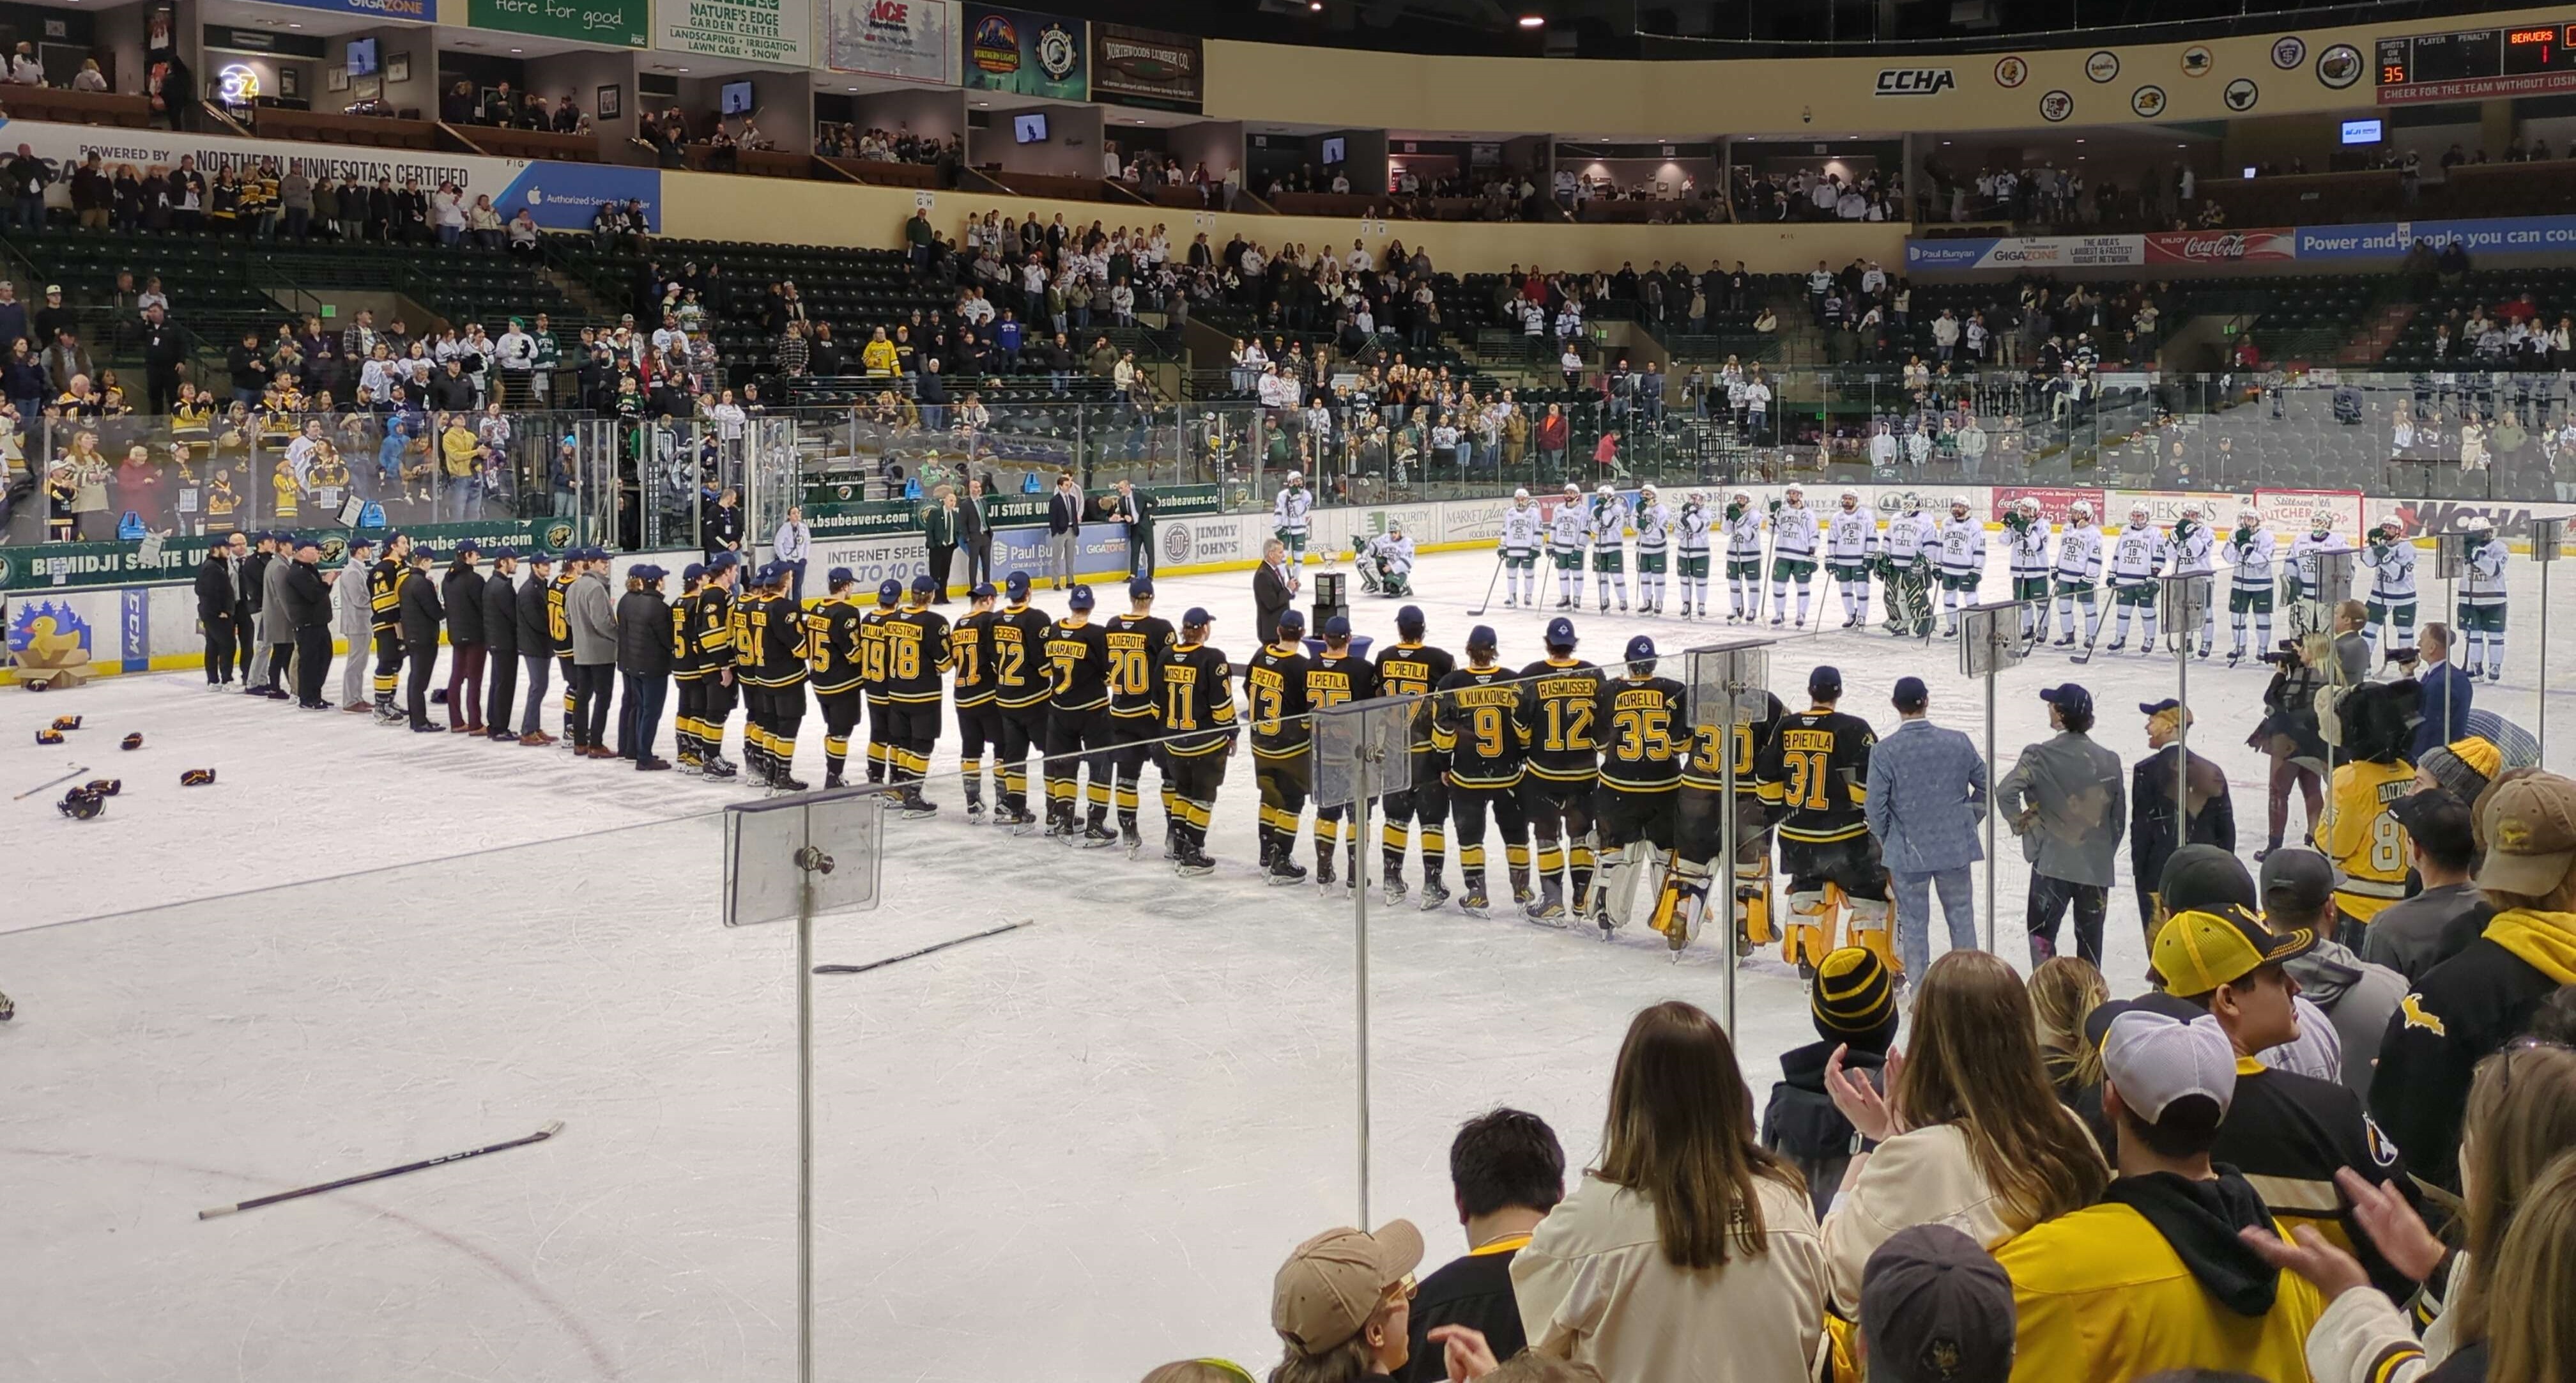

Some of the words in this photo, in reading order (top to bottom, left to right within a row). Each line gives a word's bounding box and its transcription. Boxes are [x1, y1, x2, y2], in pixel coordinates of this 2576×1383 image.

[495, 0, 537, 14] Here
[545, 0, 576, 19] for
[583, 9, 624, 29] good.
[690, 3, 746, 22] NATURE'S
[750, 11, 779, 27] EDGE
[869, 0, 908, 24] ACE
[690, 17, 734, 31] GARDEN
[739, 24, 779, 37] CENTER
[870, 20, 908, 33] Hardware
[670, 29, 735, 45] LANDSCAPING
[746, 38, 797, 52] IRRIGATION
[2380, 42, 2405, 50] SHOTS
[2418, 36, 2446, 45] PLAYER
[2458, 32, 2490, 42] PENALTY
[2511, 31, 2554, 44] BEAVERS
[688, 42, 716, 52] LAWN
[718, 45, 741, 56] CARE
[751, 49, 781, 60] SNOW
[974, 49, 1000, 61] NORTHERN
[1000, 52, 1018, 64] LIGHTS
[1106, 42, 1151, 60] NORTHWOODS
[1151, 49, 1178, 65] LUMBER
[1179, 53, 1190, 71] CO.
[1876, 70, 1955, 95] CCHA
[2384, 66, 2404, 83] 35
[2384, 88, 2417, 99] CHEER
[2419, 86, 2438, 97] FOR
[2442, 84, 2460, 95] THE
[2465, 82, 2493, 93] TEAM
[2496, 78, 2543, 91] WITHOUT
[80, 144, 148, 160] POWERED
[153, 150, 170, 161] BY
[195, 150, 284, 177] NORTHEN
[396, 164, 468, 188] CERTIFIED
[546, 194, 590, 206] Authorized
[2083, 238, 2096, 247] THE
[2184, 235, 2246, 257] Coca-Cola
[2304, 236, 2358, 251] Power
[2363, 233, 2396, 249] and
[2468, 231, 2501, 248] you
[2507, 229, 2540, 243] can
[1922, 249, 1941, 258] Paul
[1943, 249, 1975, 258] Bunyan
[1993, 249, 2058, 261] GIGAZONE
[2070, 247, 2100, 256] LARGEST
[2105, 246, 2133, 255] FASTEST
[1001, 502, 1033, 516] STATE
[1195, 524, 1238, 543] JIMMY
[828, 548, 889, 565] INTERNET
[1011, 544, 1035, 560] Paul
[1085, 543, 1126, 554] GIGAZONE
[1195, 541, 1238, 559] JOHN'S
[888, 563, 908, 580] 10
[128, 594, 142, 657] CCM
[808, 630, 831, 673] 15
[1107, 634, 1147, 649] CADEROTH
[861, 638, 885, 683] 19
[889, 636, 920, 680] 18
[953, 644, 981, 688] 21
[1052, 656, 1075, 695] 7
[1108, 649, 1149, 695] 20
[1165, 667, 1195, 683] MOSLEY
[1255, 667, 1284, 691] PIETILA
[1395, 663, 1427, 679] PIETILA
[1539, 679, 1595, 696] RASMUSSEN
[1167, 682, 1197, 730] 11
[1249, 683, 1282, 736] 13
[1616, 692, 1662, 708] MORELLI
[1473, 706, 1503, 758] 9
[1544, 698, 1597, 751] 12
[1613, 709, 1671, 761] 35
[1694, 723, 1754, 775] 30
[1783, 751, 1828, 810] 31
